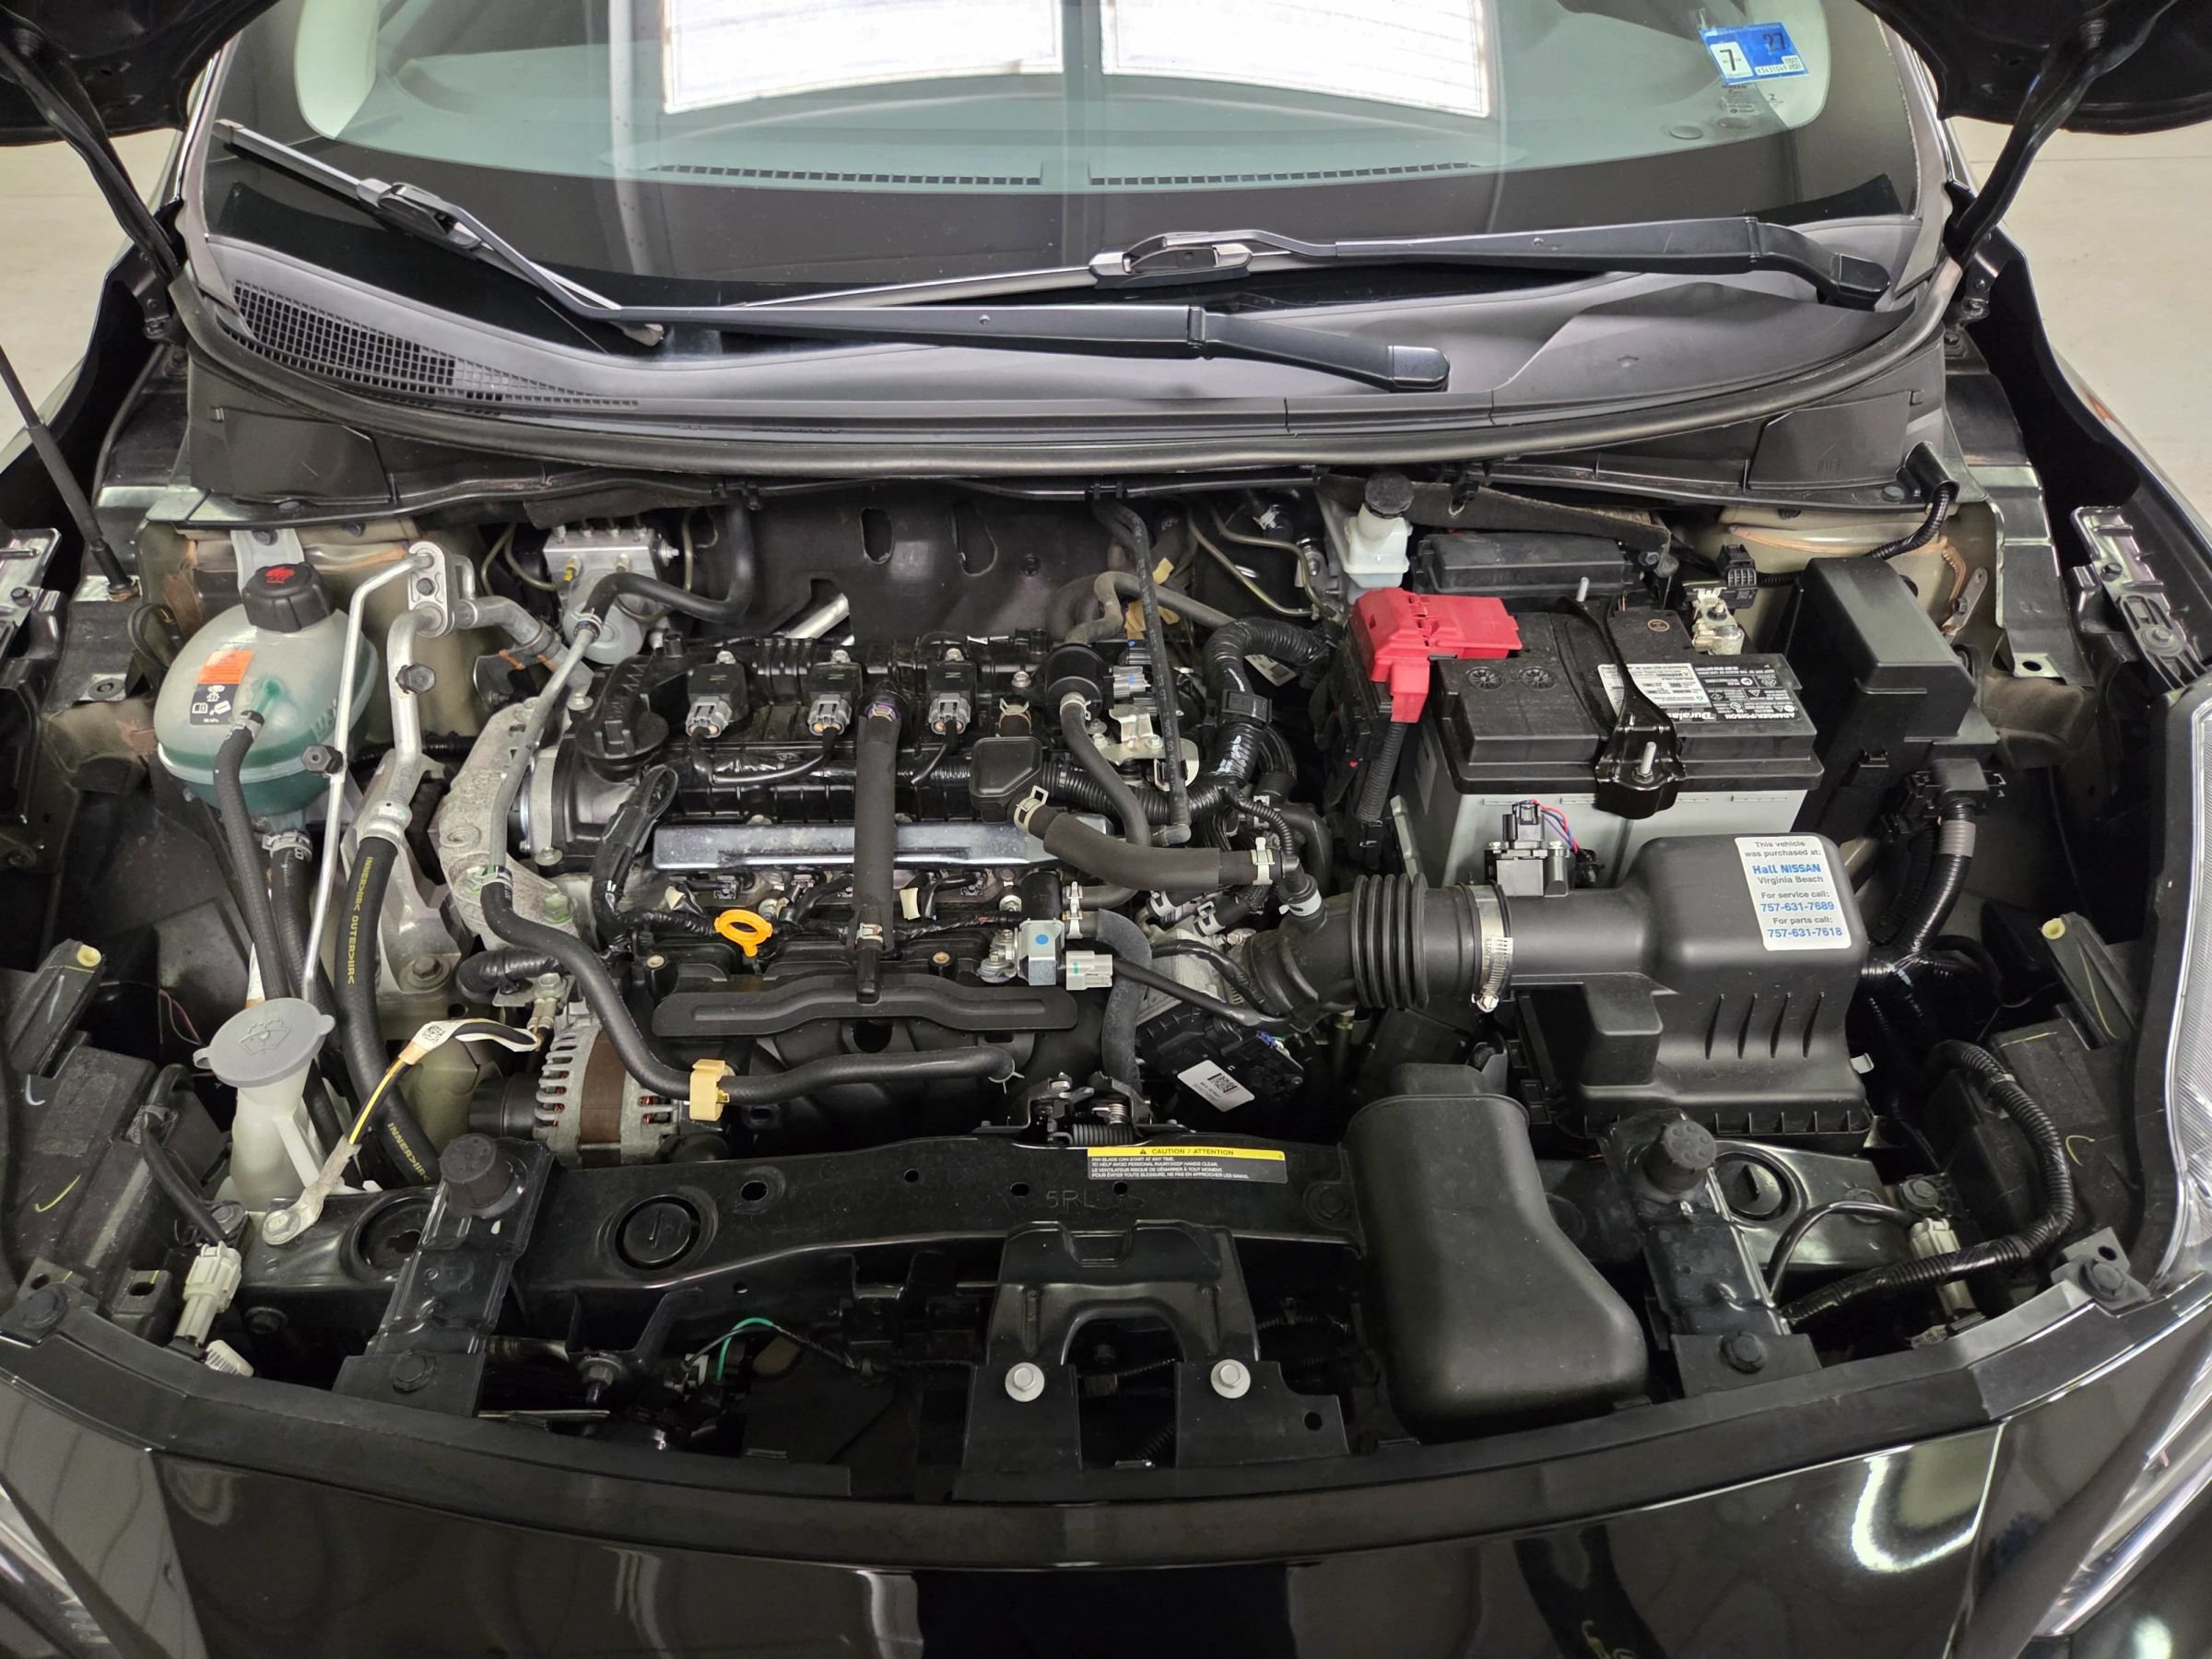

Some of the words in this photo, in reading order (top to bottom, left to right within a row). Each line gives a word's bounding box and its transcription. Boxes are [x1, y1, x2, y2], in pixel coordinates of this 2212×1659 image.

[1719, 49, 1735, 71] 7
[1665, 711, 1714, 721] Duralas
[1764, 850, 1808, 858] purchased
[1752, 865, 1778, 874] Hall
[1781, 864, 1821, 874] NISSAN
[1758, 877, 1793, 886] Virginia
[1760, 901, 1835, 912] 757-631-7689
[1790, 917, 1812, 925] parts
[1768, 927, 1842, 938] 757-631-7618
